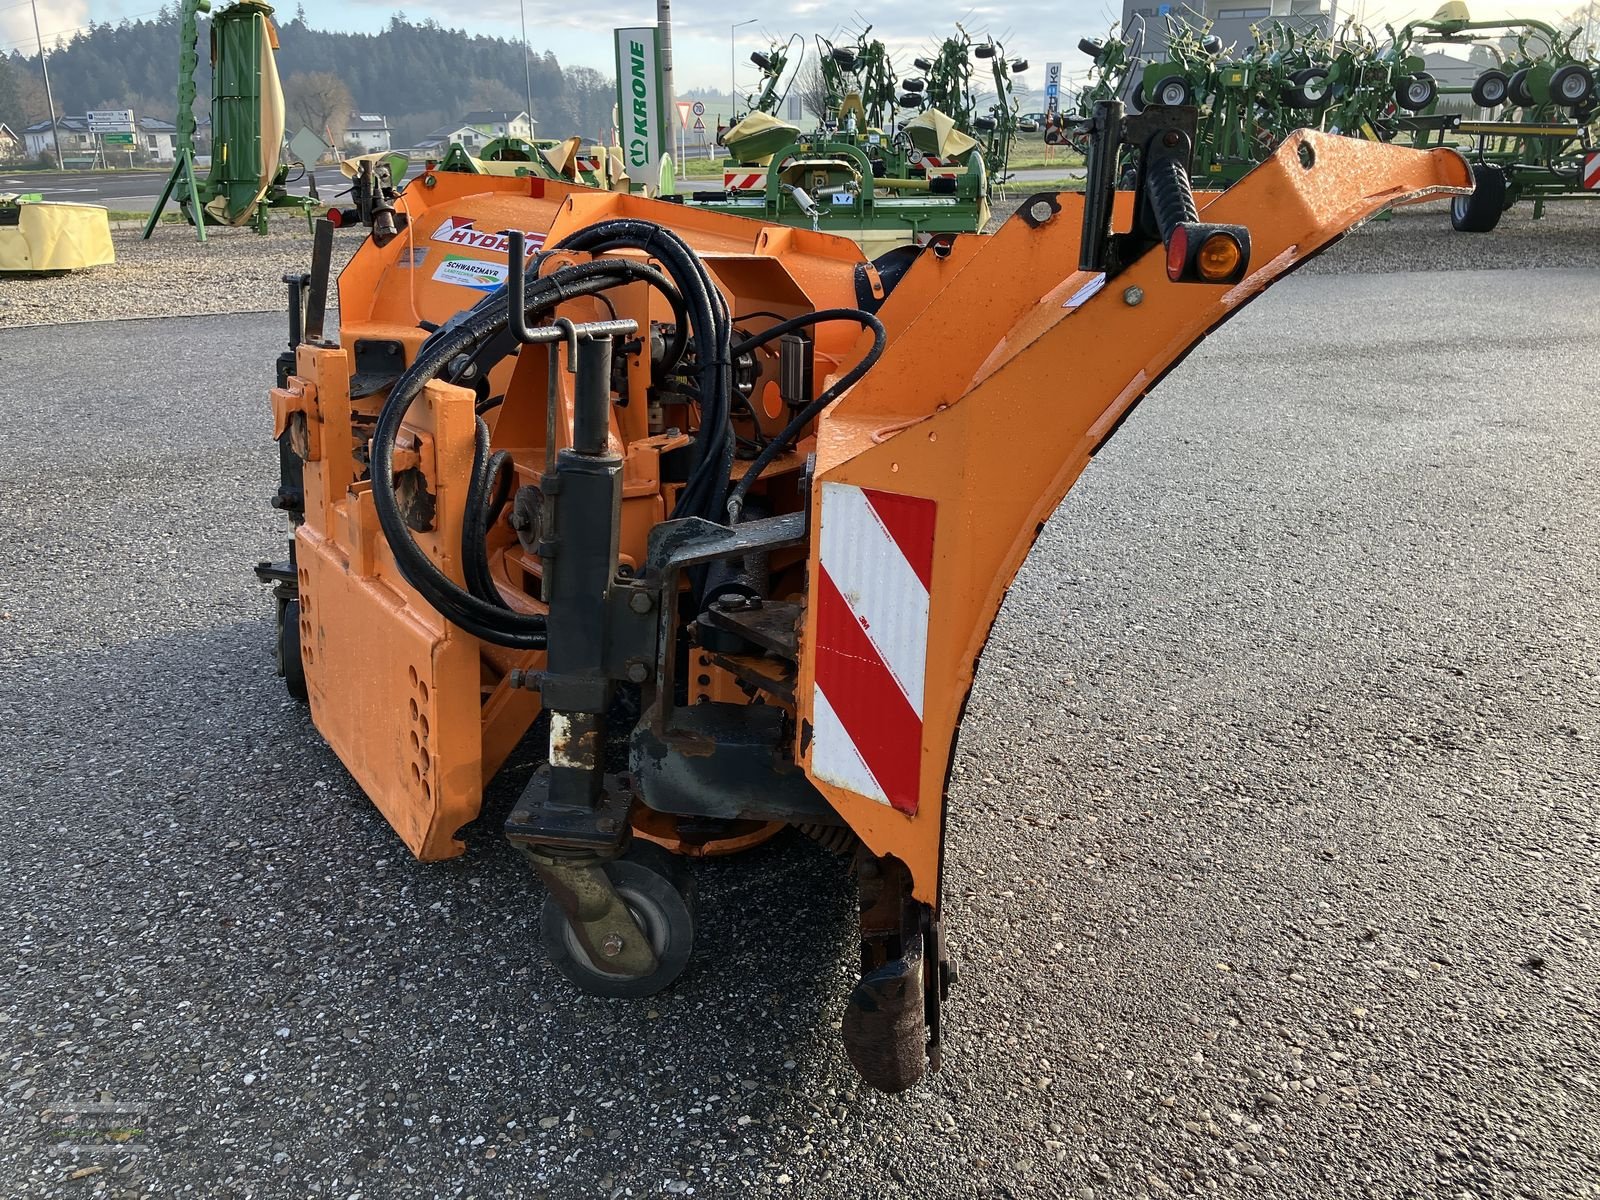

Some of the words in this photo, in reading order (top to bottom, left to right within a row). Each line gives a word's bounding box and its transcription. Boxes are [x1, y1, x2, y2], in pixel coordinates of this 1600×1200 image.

[630, 40, 649, 138] KRONE
[446, 261, 499, 276] SCHWARZMAYR
[859, 615, 870, 630] 3M
